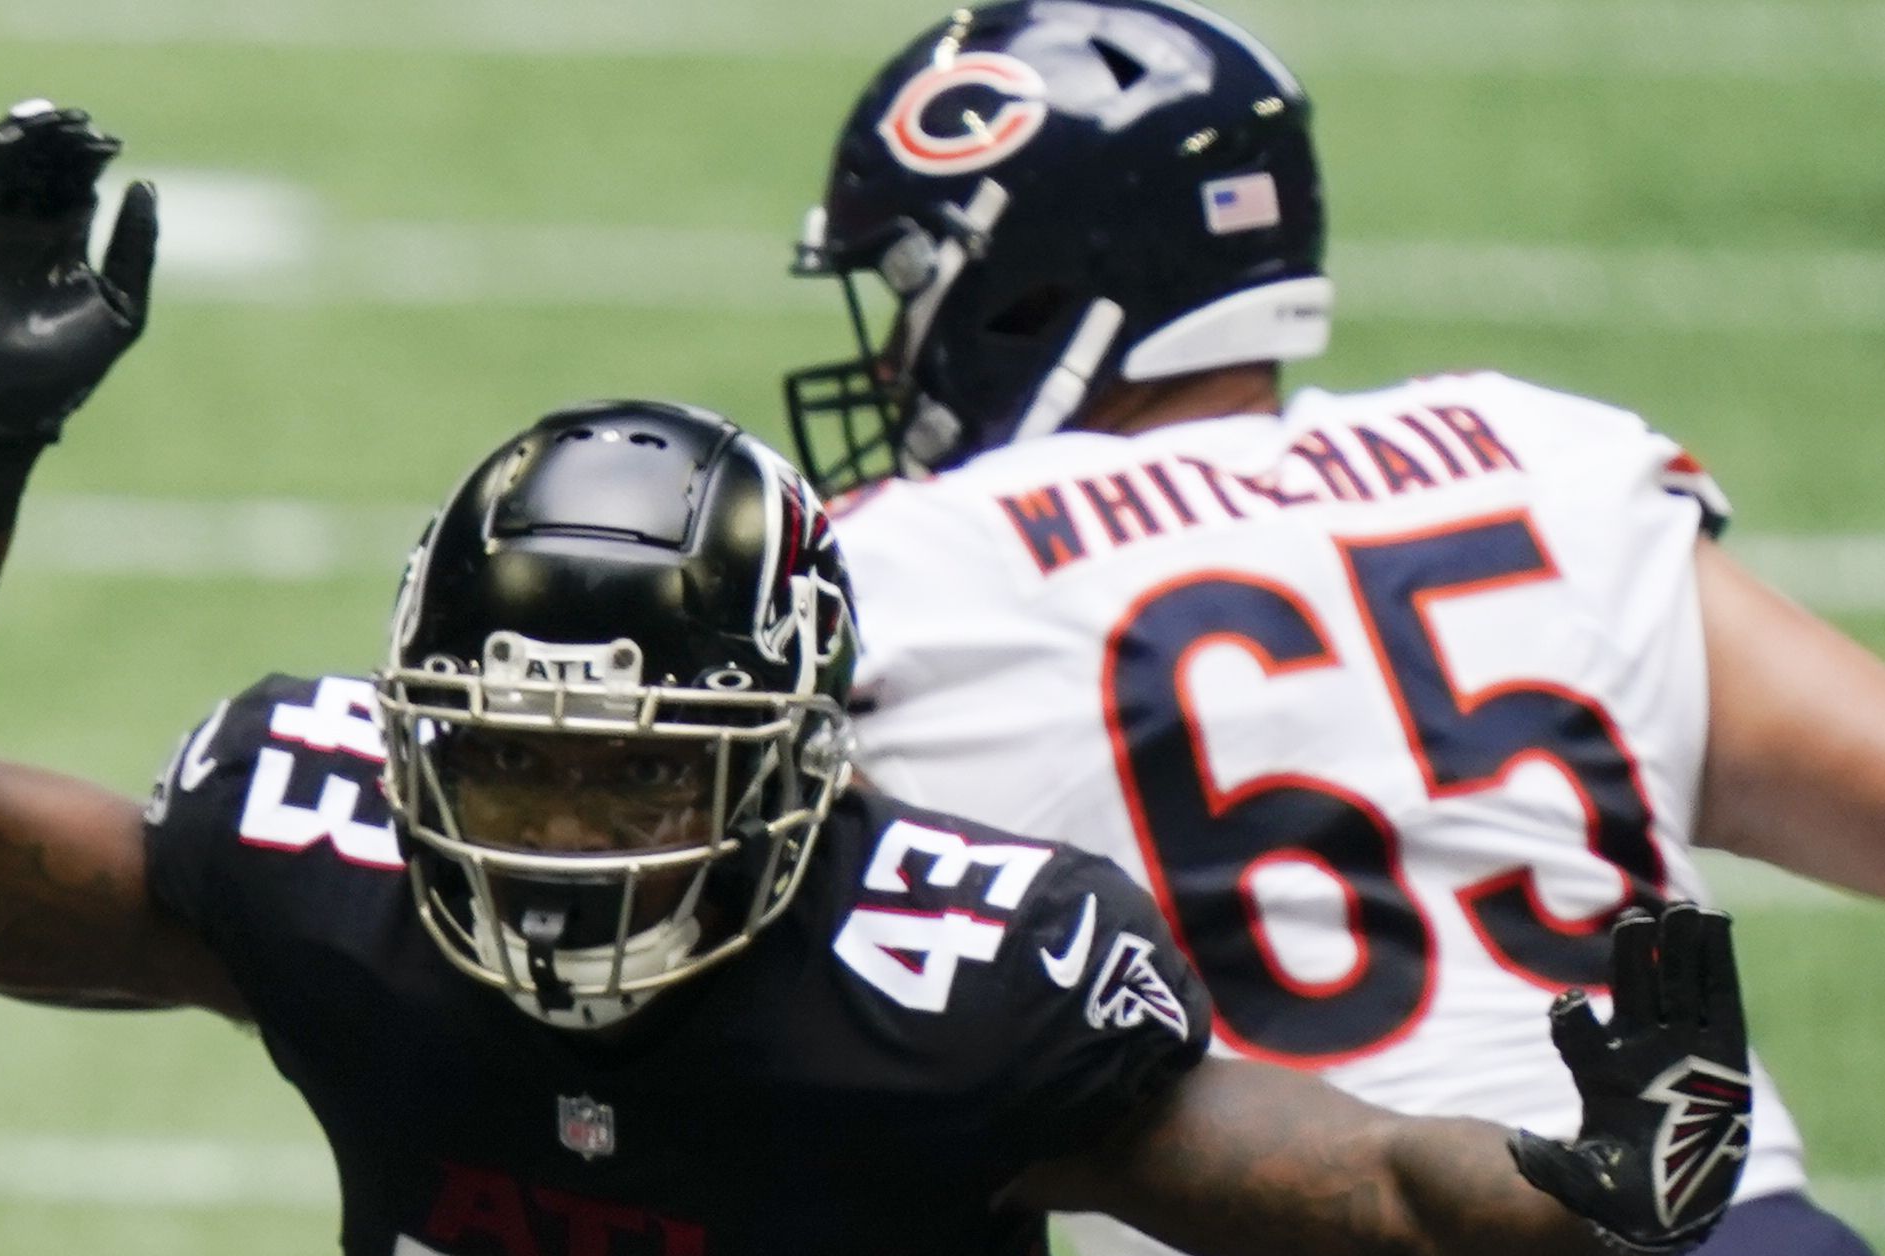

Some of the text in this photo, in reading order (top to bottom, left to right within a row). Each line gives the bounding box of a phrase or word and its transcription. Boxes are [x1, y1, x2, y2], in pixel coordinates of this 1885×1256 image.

[525, 659, 604, 682] ATL
[238, 675, 407, 871] 43
[1100, 504, 1667, 1069] 65
[832, 819, 1054, 1015] 43
